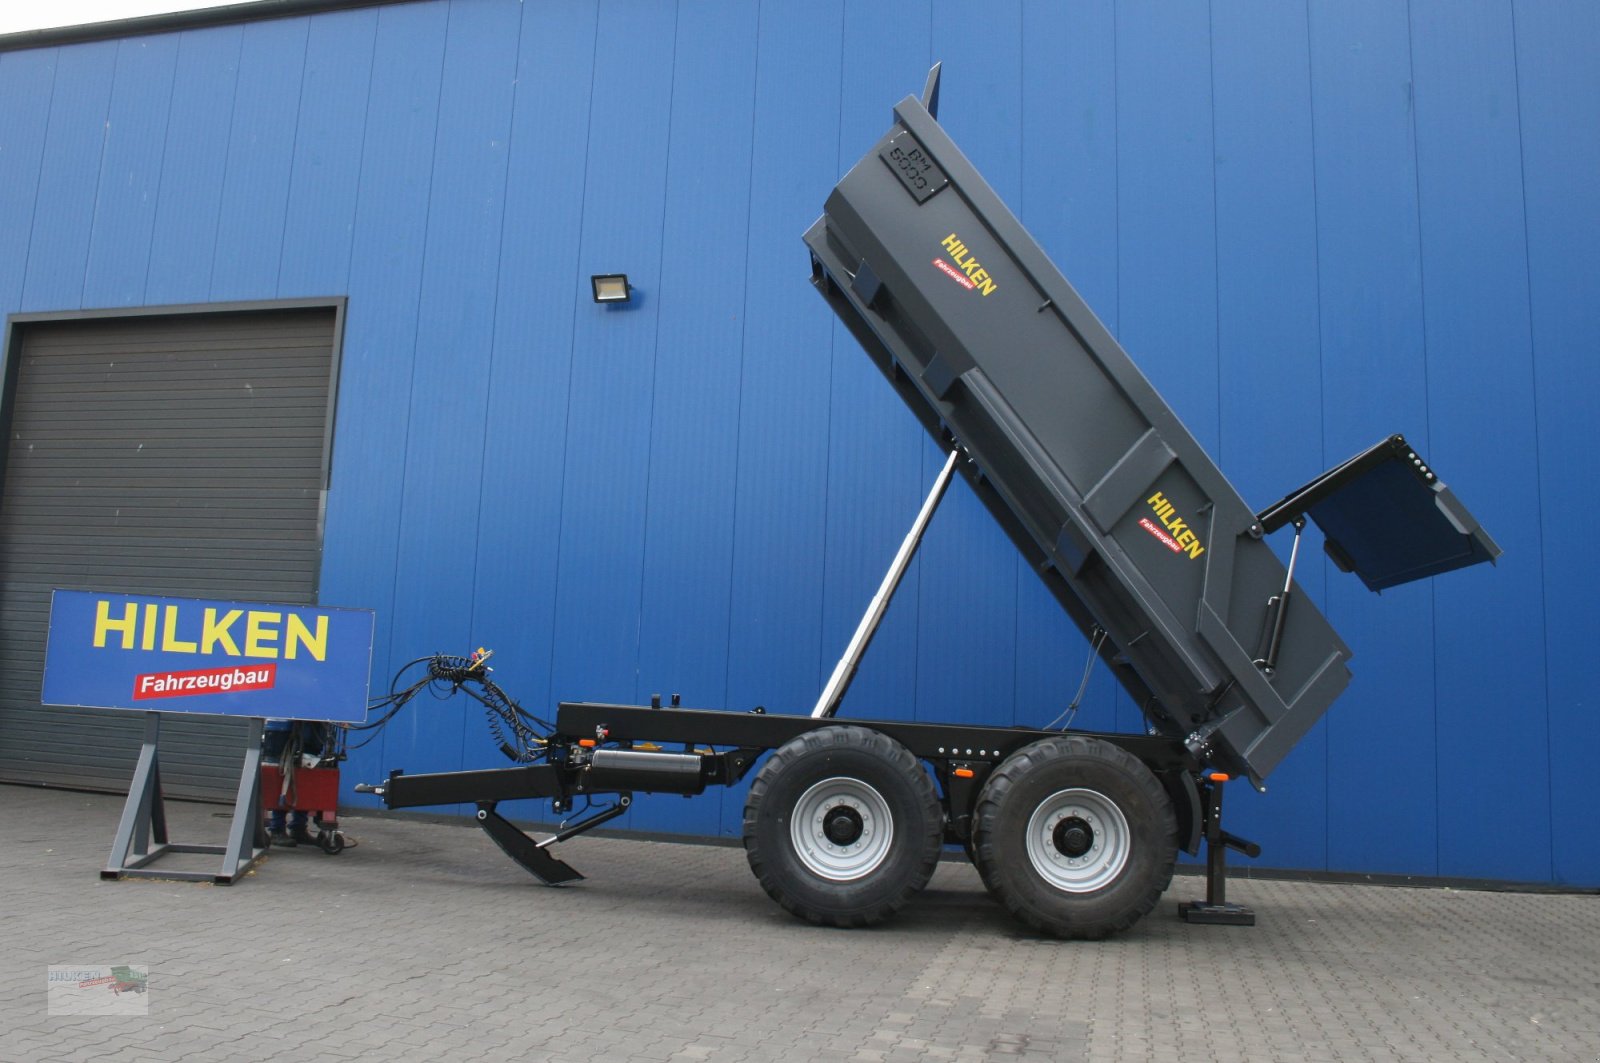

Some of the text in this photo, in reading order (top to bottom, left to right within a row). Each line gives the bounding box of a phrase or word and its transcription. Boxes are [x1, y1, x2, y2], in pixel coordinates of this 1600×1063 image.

[934, 258, 974, 289] Fahrzeugbau
[941, 233, 997, 297] HILKEN
[1139, 517, 1181, 552] Fahrzeugbau
[1147, 491, 1205, 560] HILKEN
[93, 600, 329, 661] HILKEN
[140, 668, 270, 693] Fahrzeugbau
